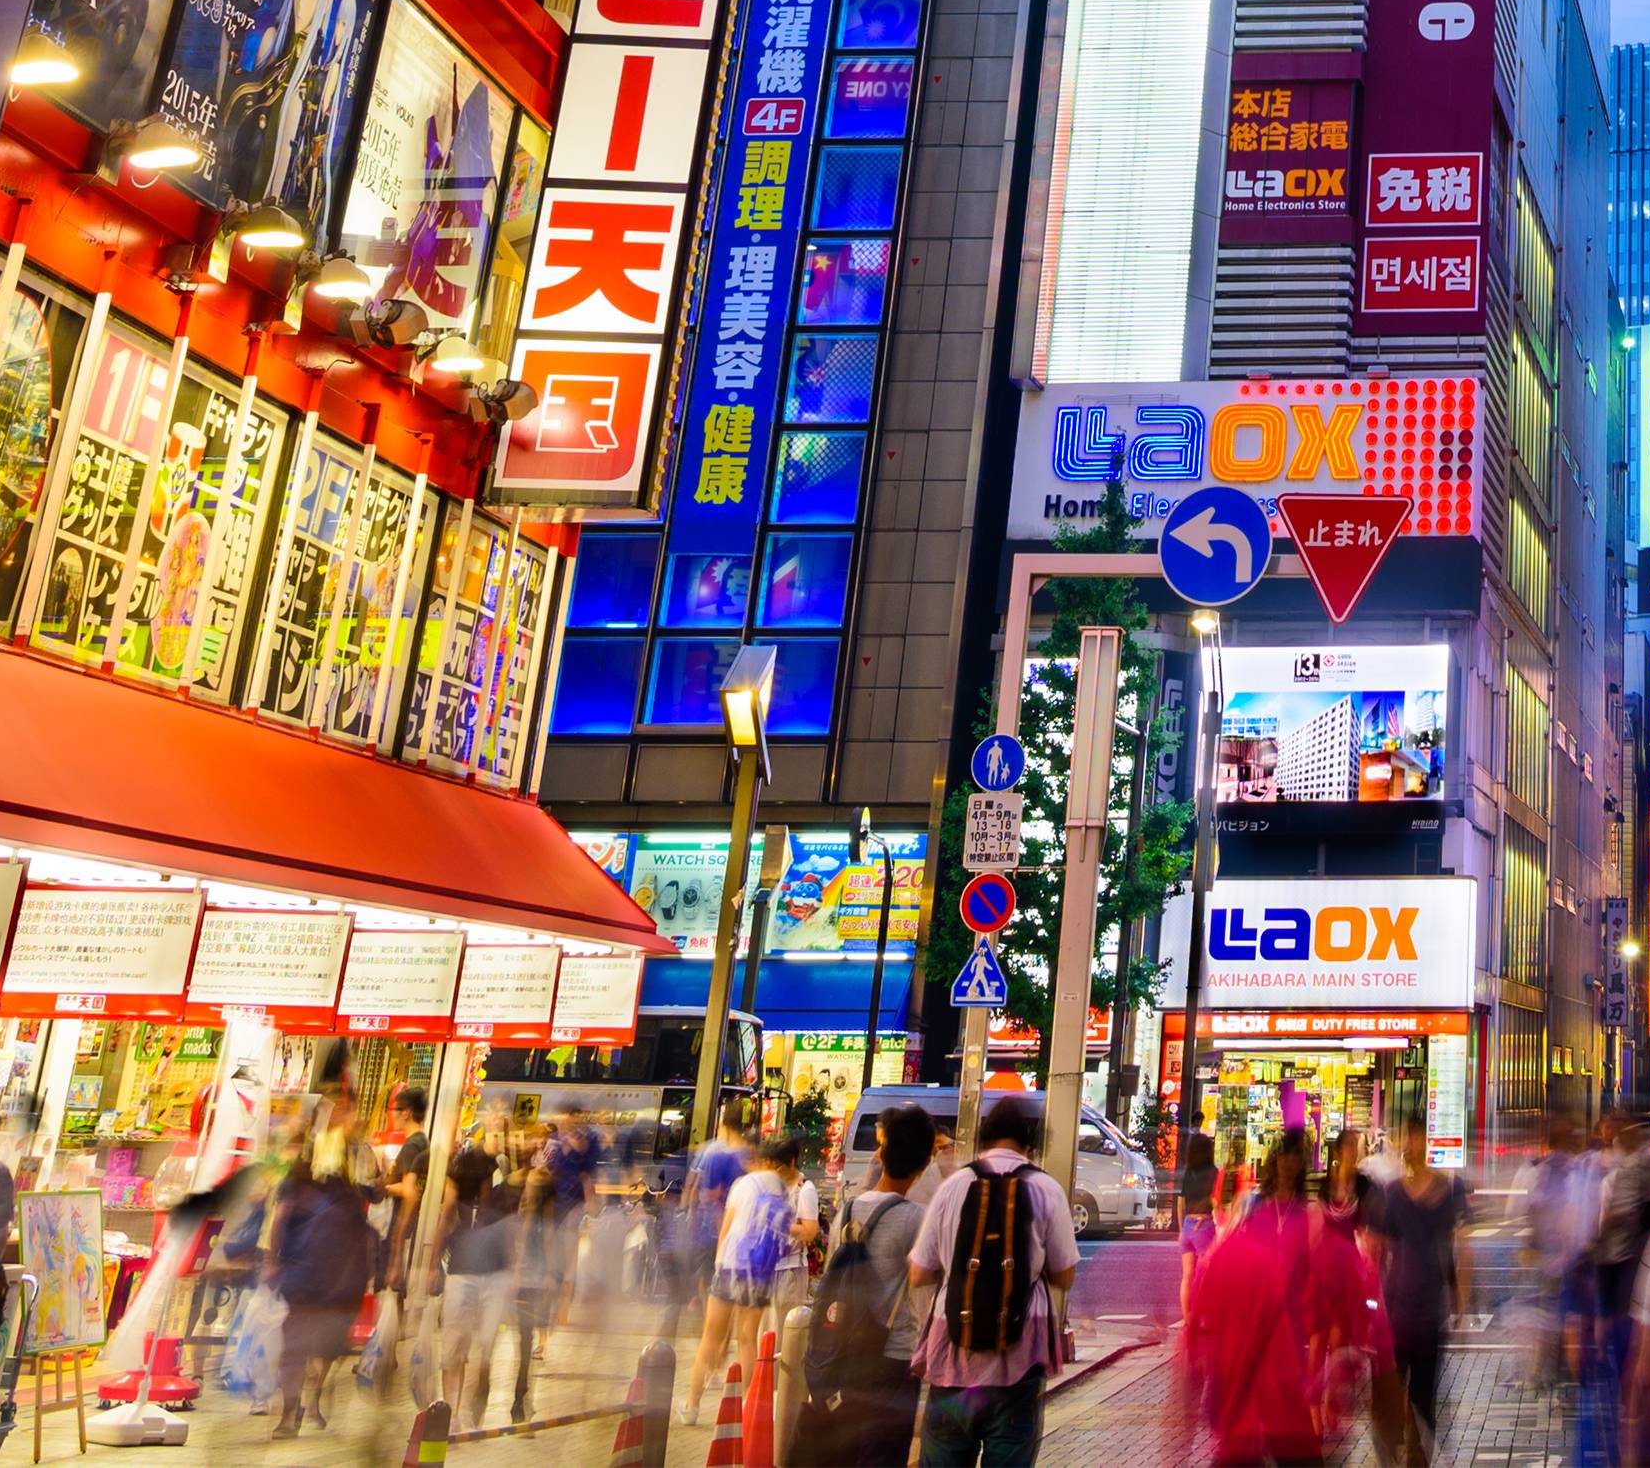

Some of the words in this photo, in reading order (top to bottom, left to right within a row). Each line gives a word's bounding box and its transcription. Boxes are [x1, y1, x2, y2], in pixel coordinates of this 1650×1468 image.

[1231, 90, 1291, 118] 本店
[1228, 122, 1349, 152] 総合家電
[1376, 166, 1472, 213] 免税
[1224, 201, 1254, 211] Home
[1257, 201, 1315, 211] Electronics
[1318, 200, 1346, 211] Store
[1371, 257, 1472, 293] 면세점
[1304, 523, 1382, 547] 止まれ
[653, 853, 711, 866] WATCH
[1207, 973, 1307, 987] AKIHABARA
[1313, 973, 1349, 987] MAIN
[1354, 973, 1417, 987] STORE
[1313, 1019, 1344, 1031] DUTY
[1347, 1019, 1374, 1031] FREE
[1377, 1018, 1417, 1031] STORE
